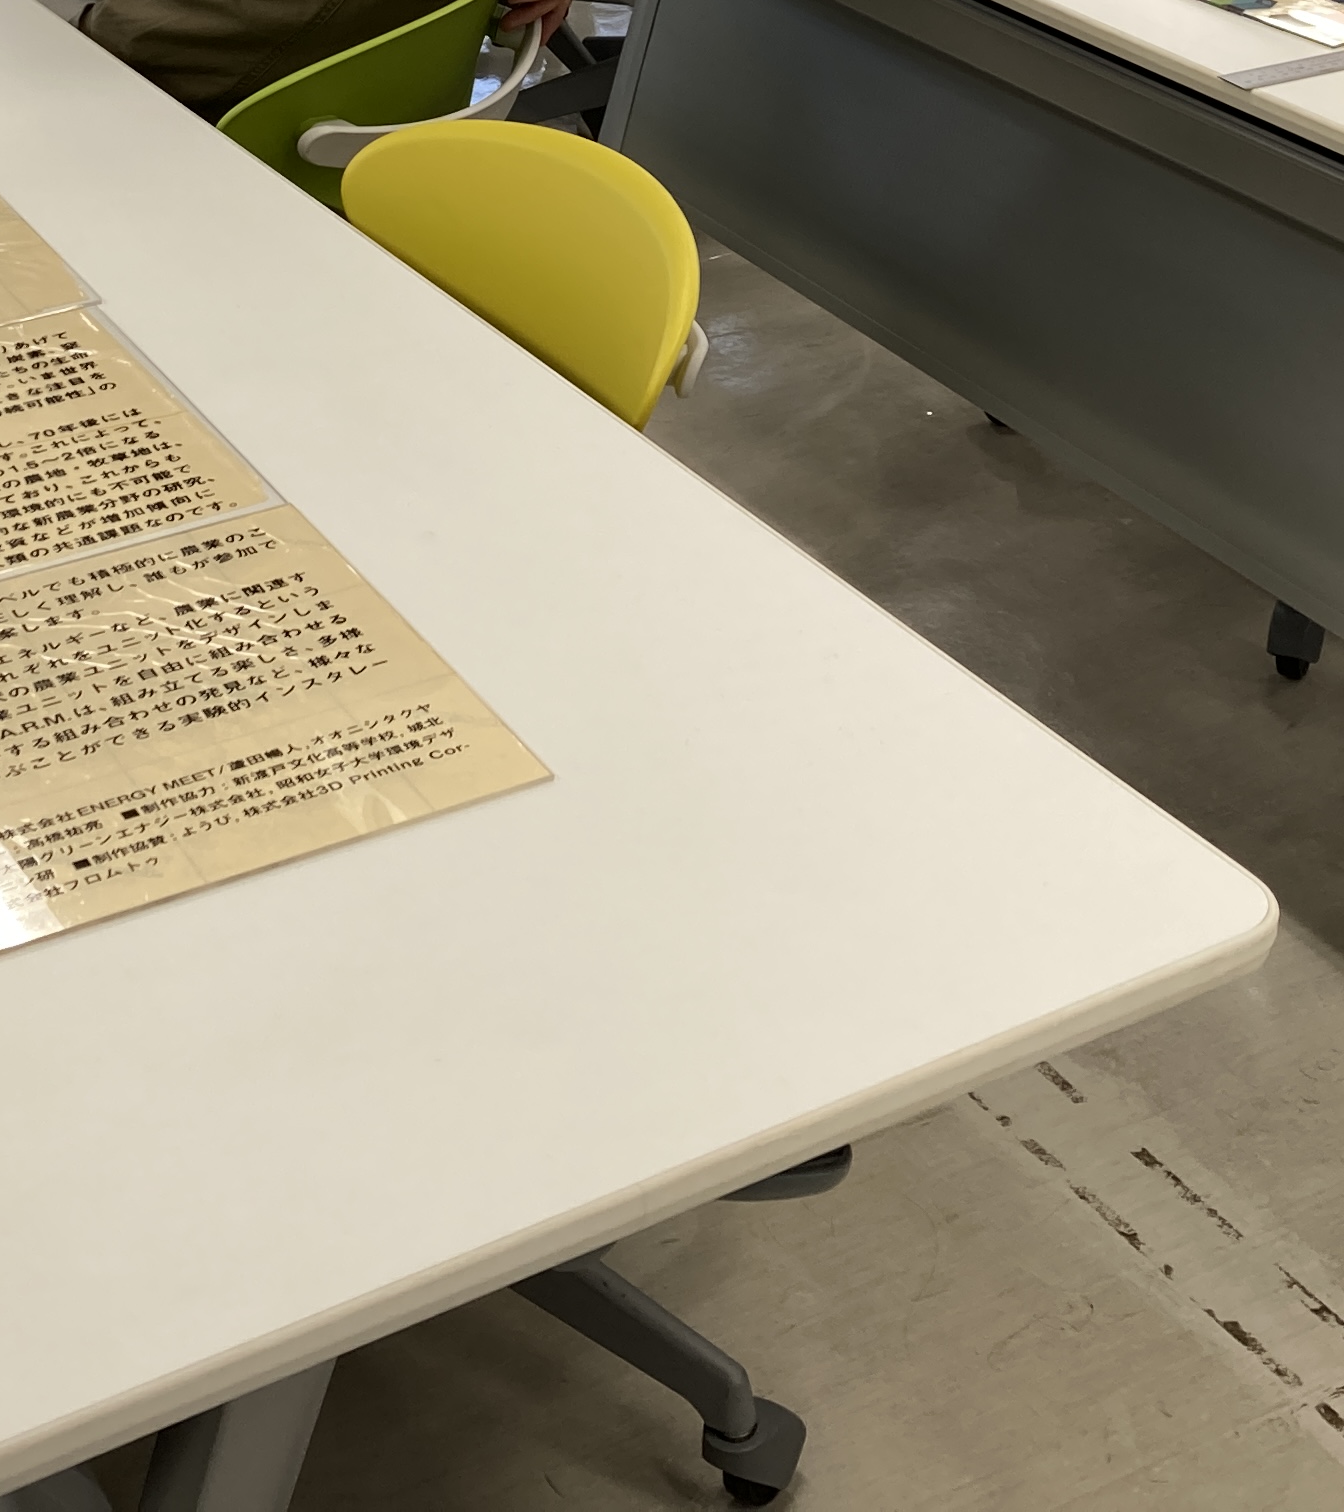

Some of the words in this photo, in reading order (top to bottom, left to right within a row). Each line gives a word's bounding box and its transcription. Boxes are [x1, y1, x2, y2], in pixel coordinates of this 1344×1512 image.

[403, 715, 444, 733] 城北
[347, 755, 426, 786] Printing
[426, 740, 472, 761] Cor-
